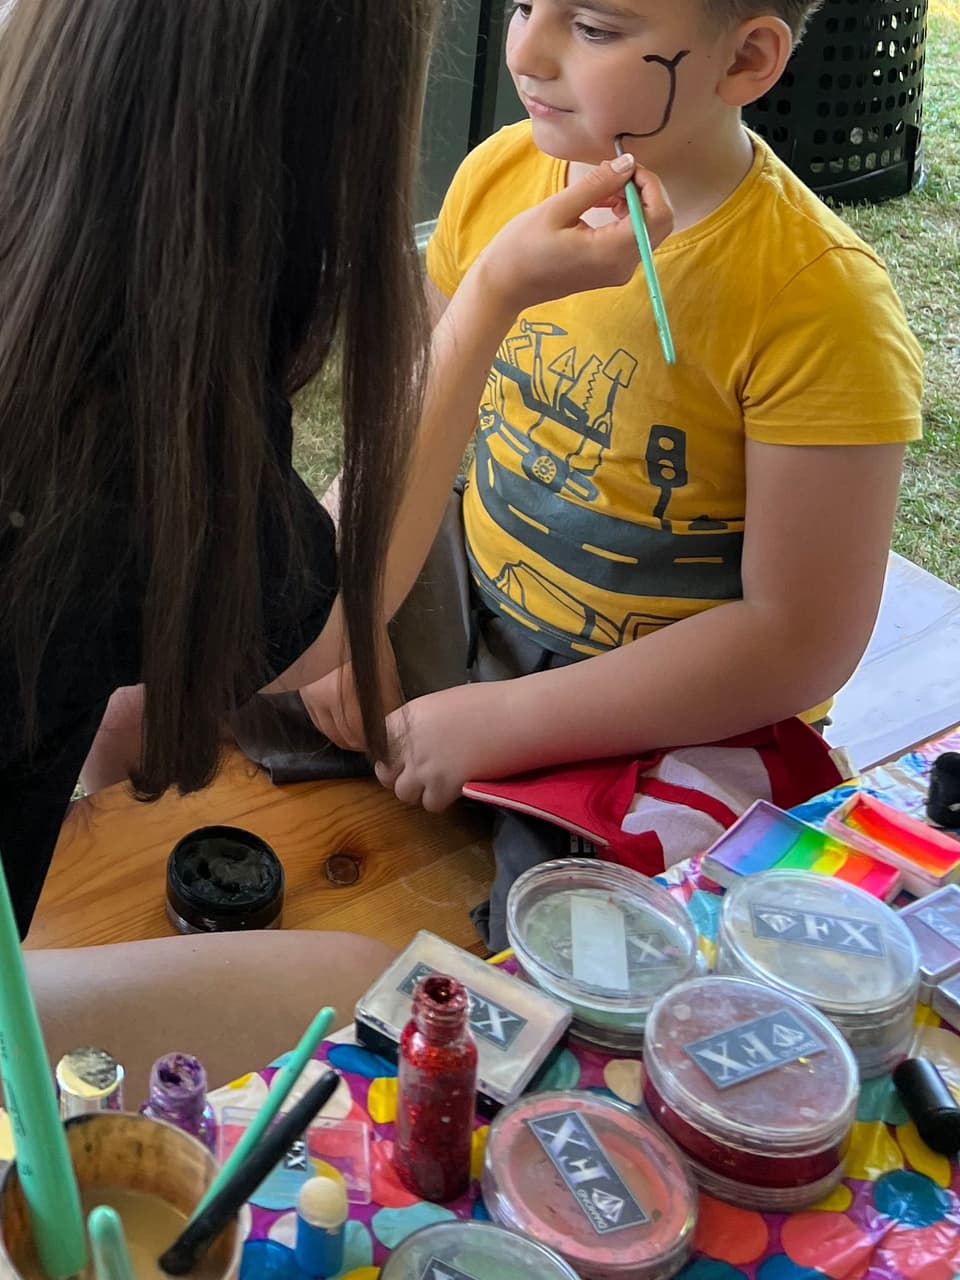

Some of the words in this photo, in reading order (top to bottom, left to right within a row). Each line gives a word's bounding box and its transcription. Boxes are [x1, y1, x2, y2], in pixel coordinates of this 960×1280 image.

[802, 913, 878, 951] FX
[694, 1030, 781, 1081] FX
[535, 1116, 611, 1188] FX
